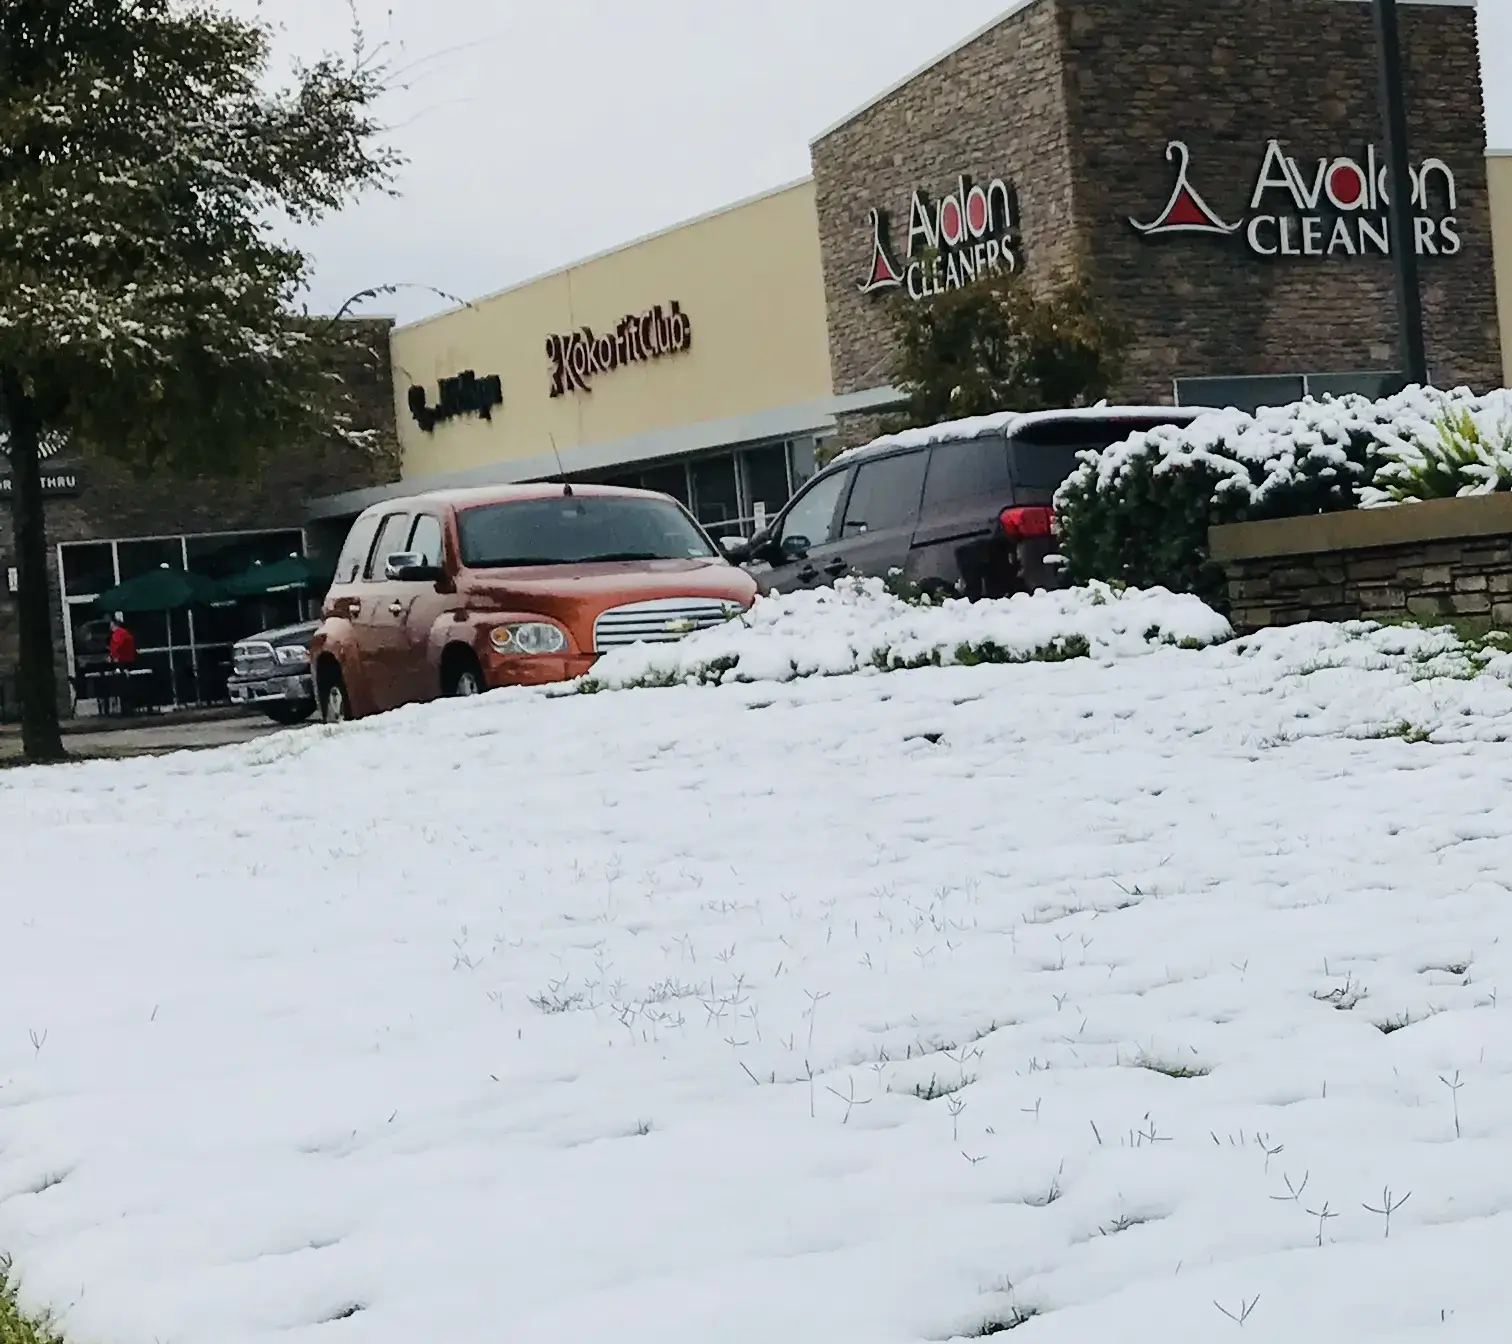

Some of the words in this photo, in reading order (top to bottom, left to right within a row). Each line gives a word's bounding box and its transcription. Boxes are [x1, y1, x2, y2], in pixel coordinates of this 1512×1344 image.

[907, 174, 1010, 258] Avalon
[1247, 215, 1461, 255] CLEANRS
[40, 475, 76, 489] THRU
